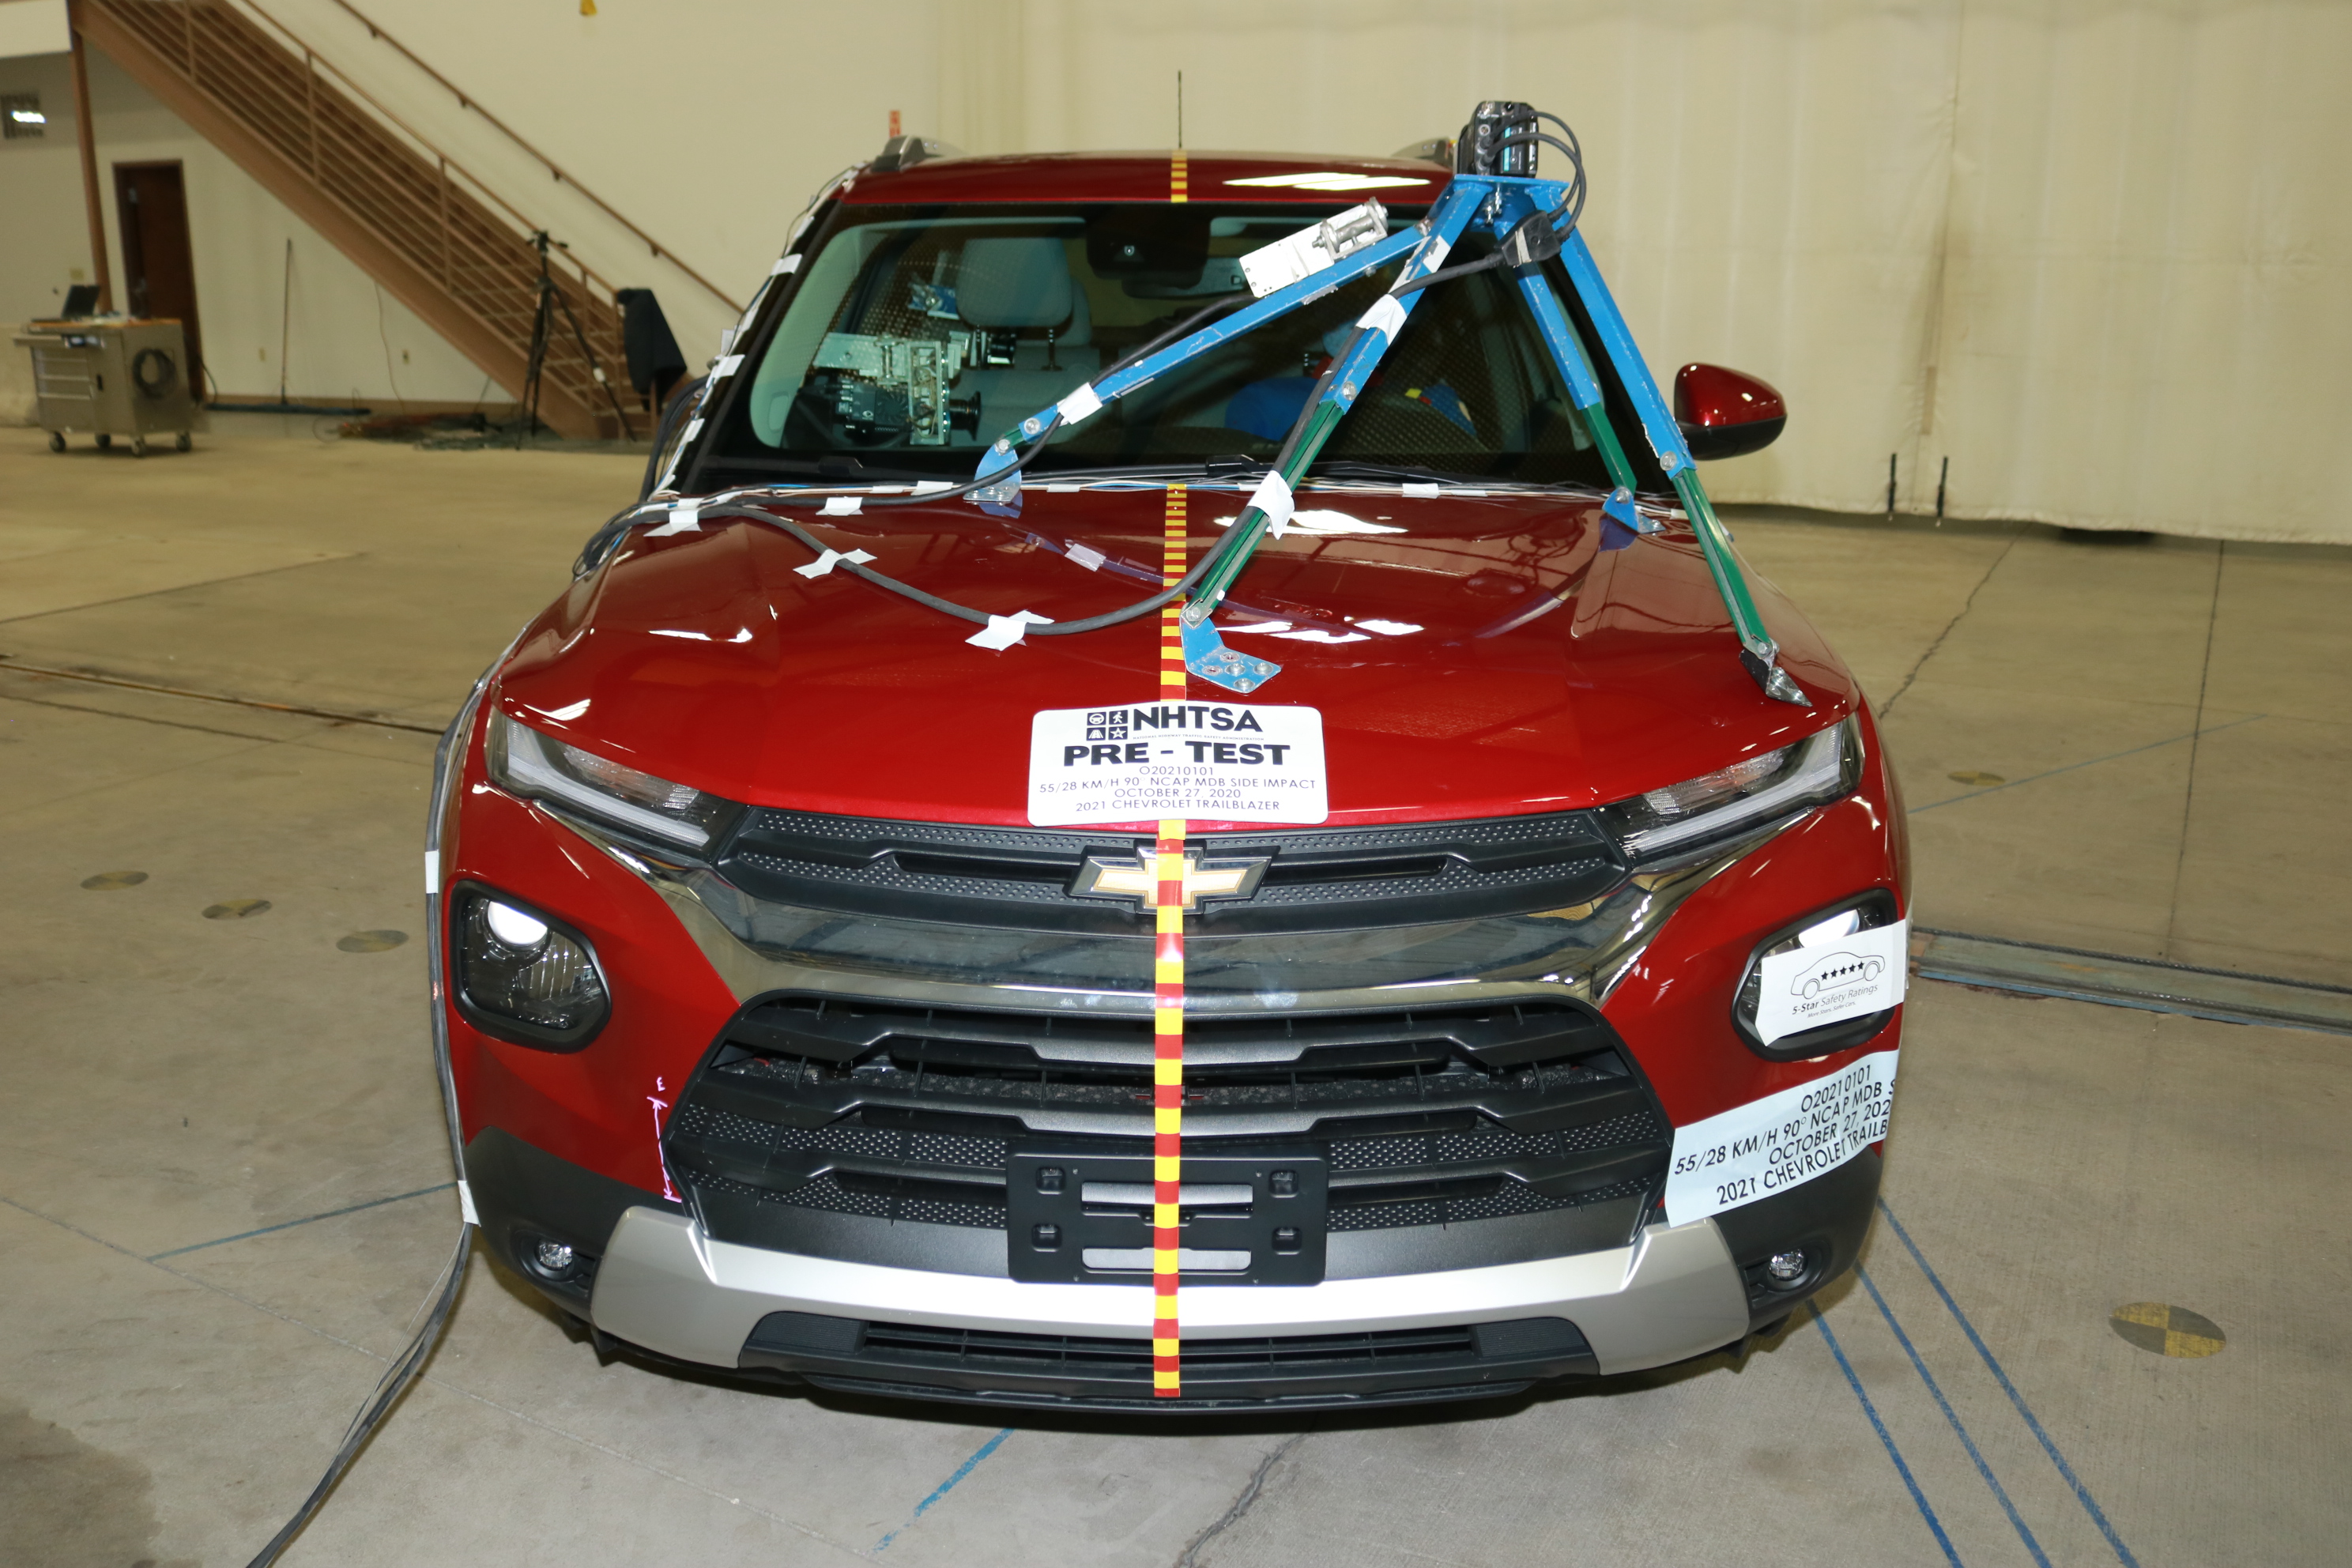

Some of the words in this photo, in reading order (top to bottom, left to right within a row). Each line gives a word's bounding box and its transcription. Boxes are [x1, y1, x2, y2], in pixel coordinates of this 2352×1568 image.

[1133, 705, 1264, 733] NHTSA
[1064, 742, 1150, 767] PRE
[1185, 741, 1291, 766] TEST
[1039, 781, 1077, 793] 55/28
[1082, 778, 1119, 790] KM/H
[1150, 777, 1190, 786] NCAP
[1194, 778, 1226, 787] MDB
[1231, 778, 1259, 788] SIDE
[1263, 778, 1316, 789] IMPACT
[1114, 788, 1180, 797] OCTOBER
[1209, 789, 1242, 798] 2020
[1075, 801, 1106, 812] 2021
[1112, 799, 1191, 809] CHEVROLET
[1196, 799, 1280, 810] TRAILBLAZER
[1792, 1001, 1819, 1015] 5-Star
[1820, 993, 1847, 1007] Safety
[1848, 985, 1879, 998] Ratings
[1674, 1145, 1727, 1175] 55/28
[1732, 1128, 1778, 1159] KM/H
[1810, 1096, 1849, 1129] NCAP
[1852, 1081, 1882, 1108] MDB
[1769, 1122, 1838, 1165] OCTOBER
[1717, 1177, 1756, 1205] 2021
[1763, 1138, 1845, 1190] CHEVROLET
